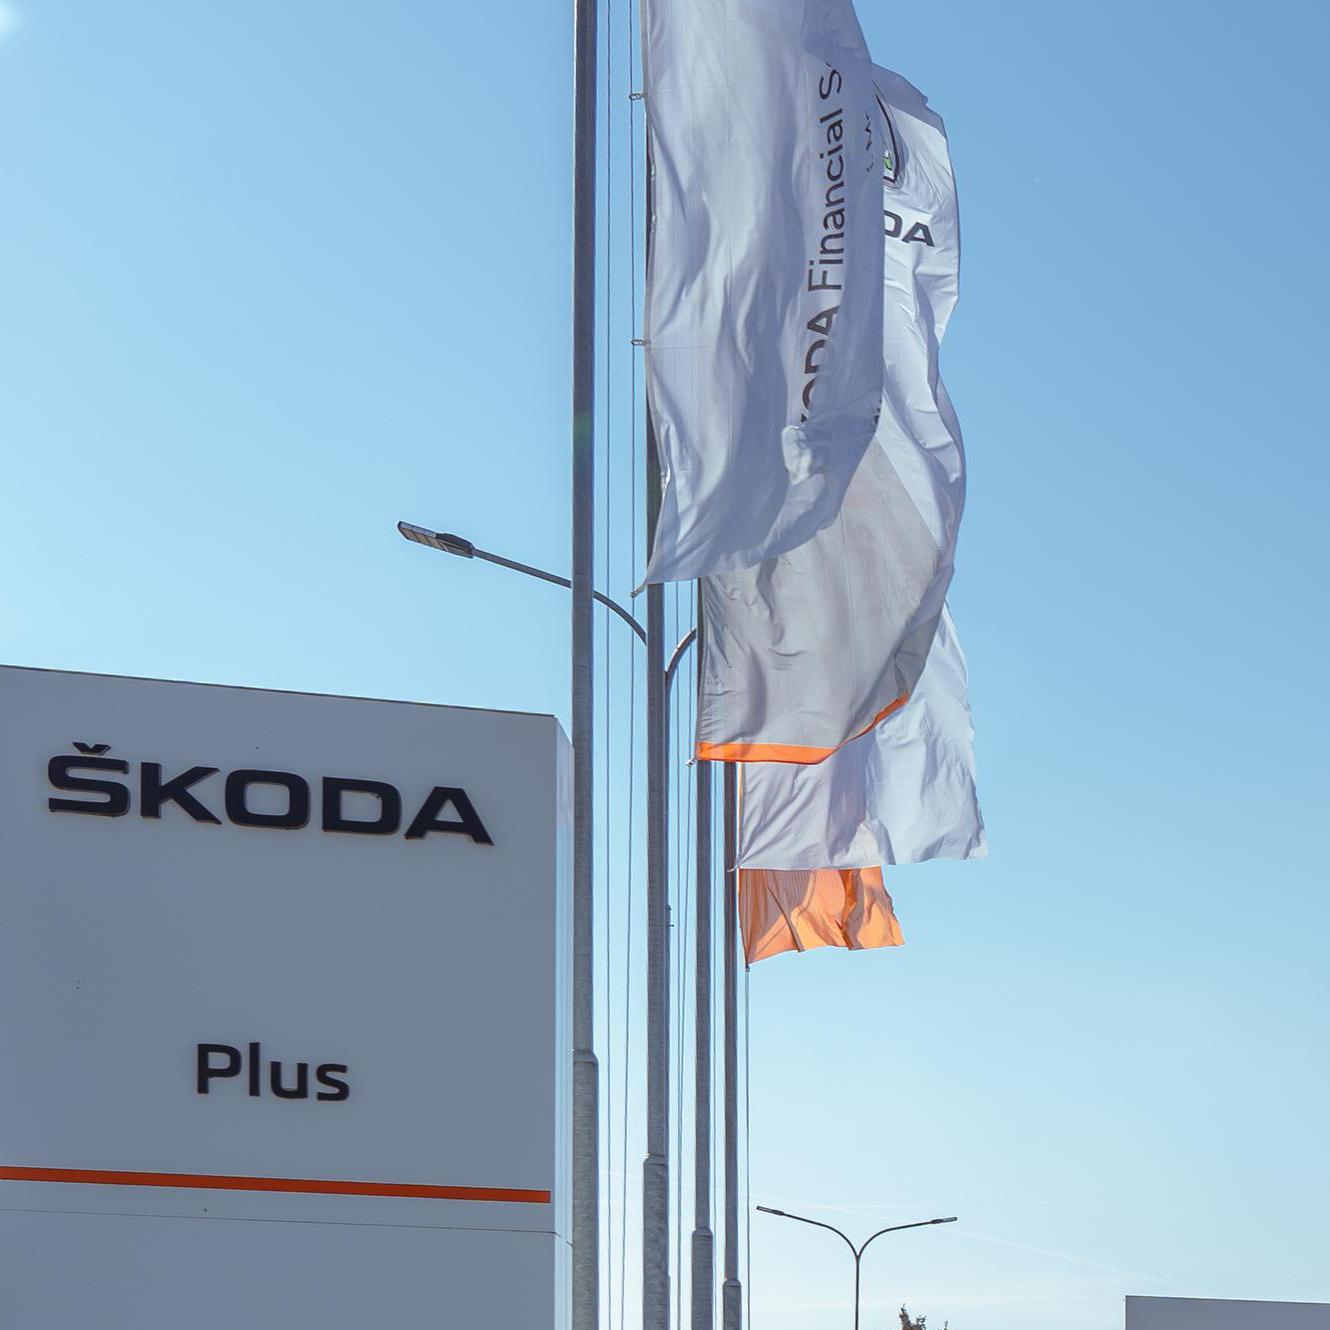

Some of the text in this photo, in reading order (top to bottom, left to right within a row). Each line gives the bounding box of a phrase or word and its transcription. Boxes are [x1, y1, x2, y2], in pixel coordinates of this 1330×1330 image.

[808, 108, 846, 292] Financial
[48, 741, 495, 846] ŠKODA
[196, 1042, 350, 1102] Plus
